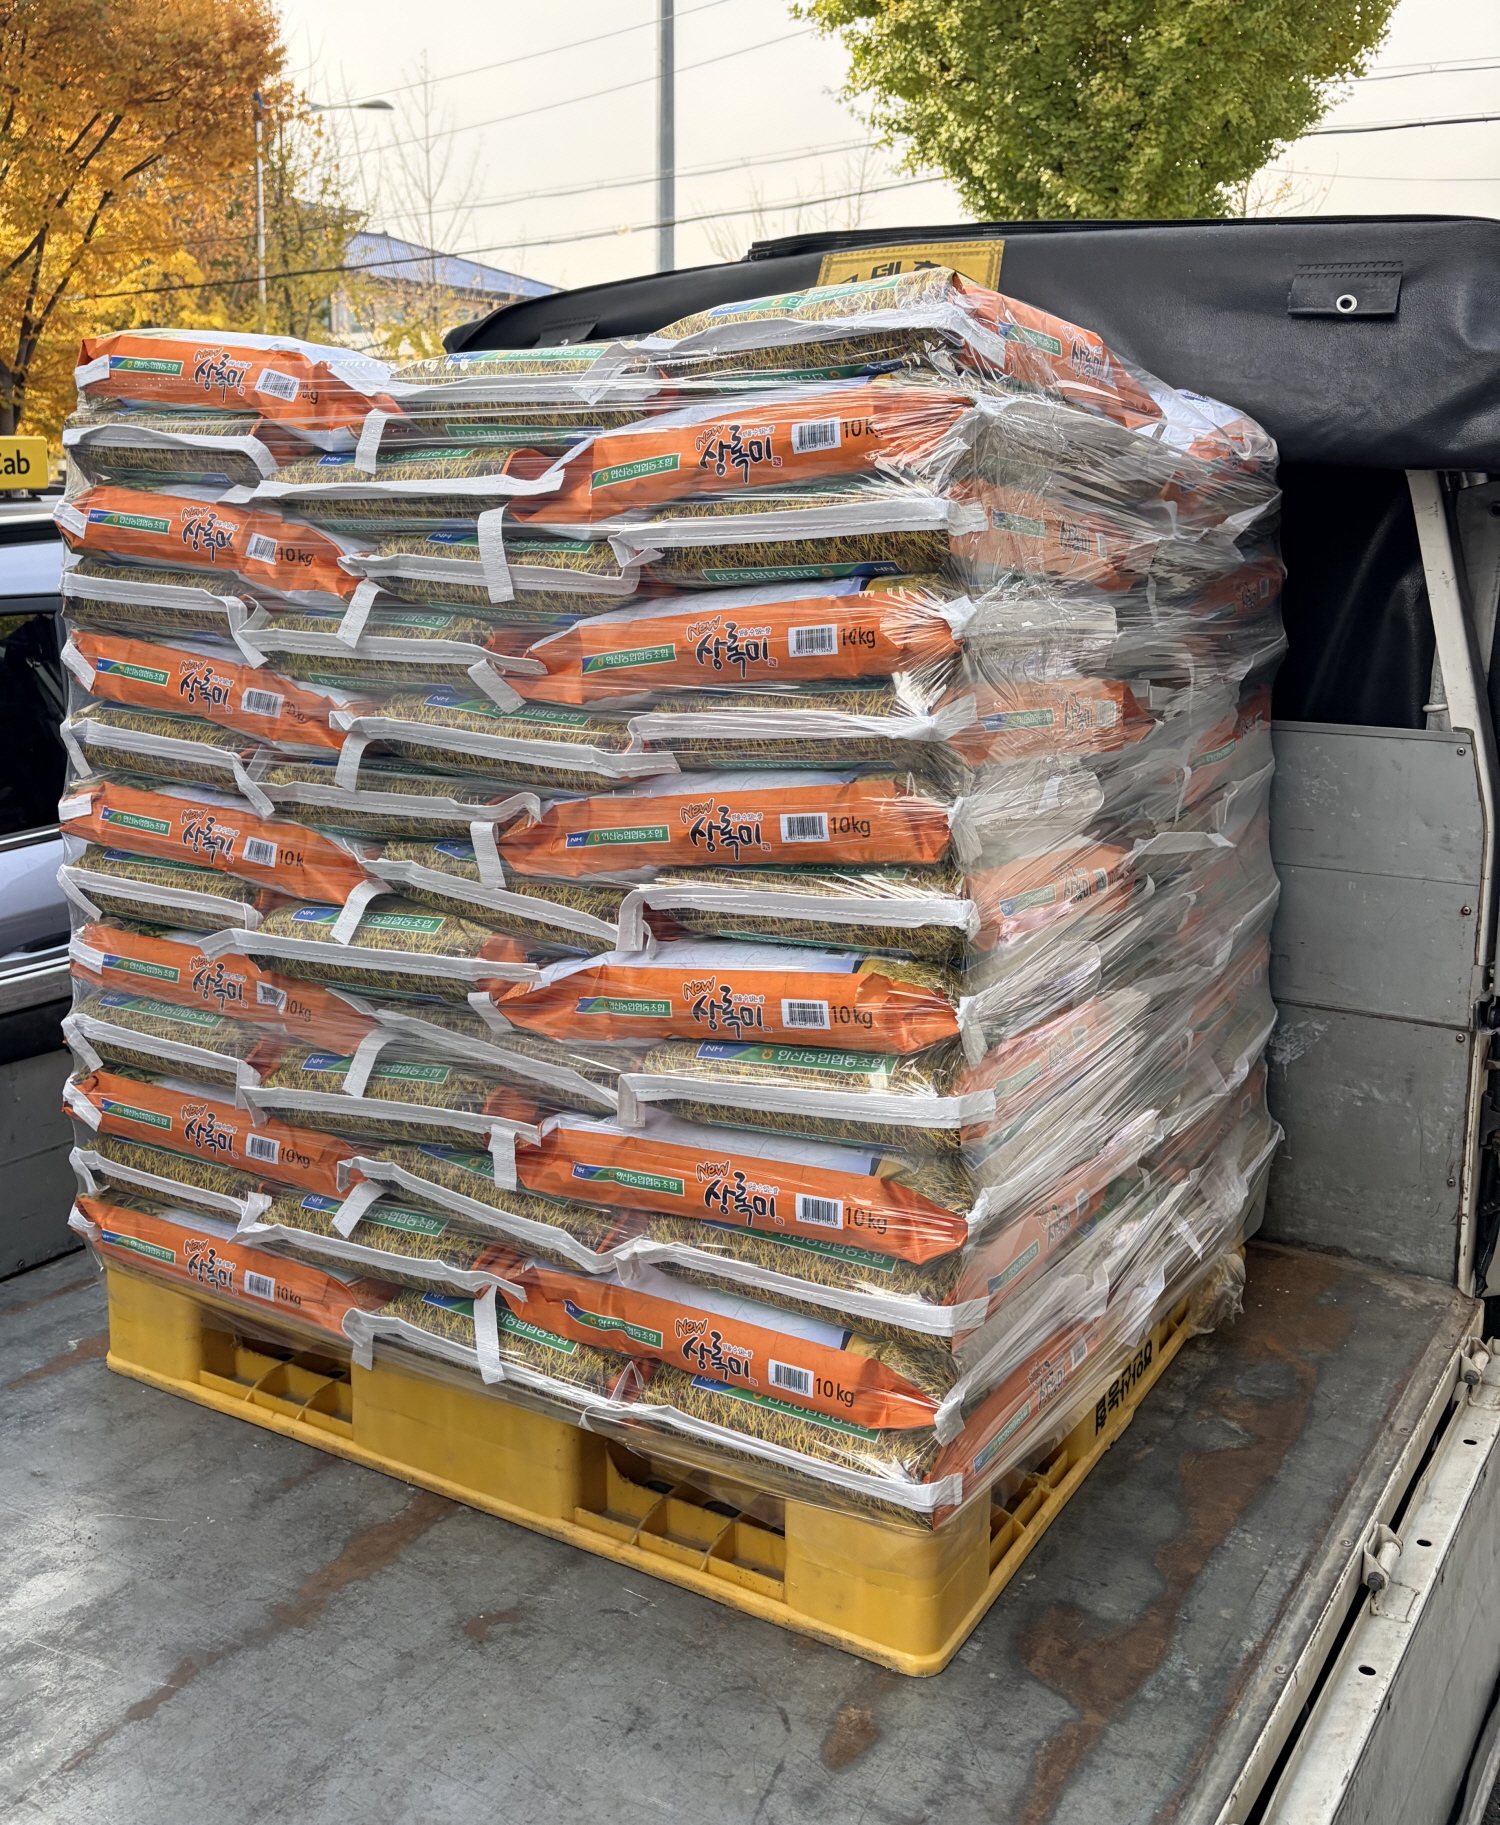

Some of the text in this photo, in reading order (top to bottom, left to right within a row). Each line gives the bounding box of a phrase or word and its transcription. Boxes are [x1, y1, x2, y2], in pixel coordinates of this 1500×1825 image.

[193, 347, 224, 362] New
[194, 353, 244, 402] 상록미
[695, 421, 726, 451] New
[0, 449, 30, 475] ab
[699, 424, 773, 484] 상록미
[181, 506, 210, 521] New
[182, 513, 233, 562] 상록미
[278, 546, 315, 566] 10kg
[686, 615, 722, 641] New
[696, 622, 769, 679] 상록미
[180, 667, 230, 714] 상록미
[181, 809, 208, 824] New
[680, 798, 714, 823] New
[690, 806, 762, 861] 상록미
[830, 817, 871, 837] 10kg
[278, 849, 304, 867] 10k
[300, 909, 434, 929] NH 산농업협동조합
[193, 963, 243, 1011] 상록미
[682, 976, 716, 999] New
[286, 999, 312, 1022] 10kg
[692, 984, 763, 1039] 상록미
[831, 1006, 873, 1028] 10kg
[309, 1057, 441, 1079] NH 산농업협동조합
[778, 1050, 886, 1070] 안산농업협동조합
[181, 1104, 208, 1119] New
[184, 1113, 236, 1157] 상록미
[280, 1147, 311, 1169] 10kg
[696, 1160, 731, 1182] New
[704, 1171, 776, 1227] 상록미
[308, 1195, 438, 1230] NH 산농업협동조합
[846, 1206, 888, 1234] 10kg
[183, 1239, 209, 1254] New
[188, 1249, 234, 1291] 상록미
[276, 1286, 301, 1307] 10kg
[674, 1318, 709, 1338] New
[682, 1331, 750, 1382] 상록미
[815, 1377, 855, 1407] 10kg
